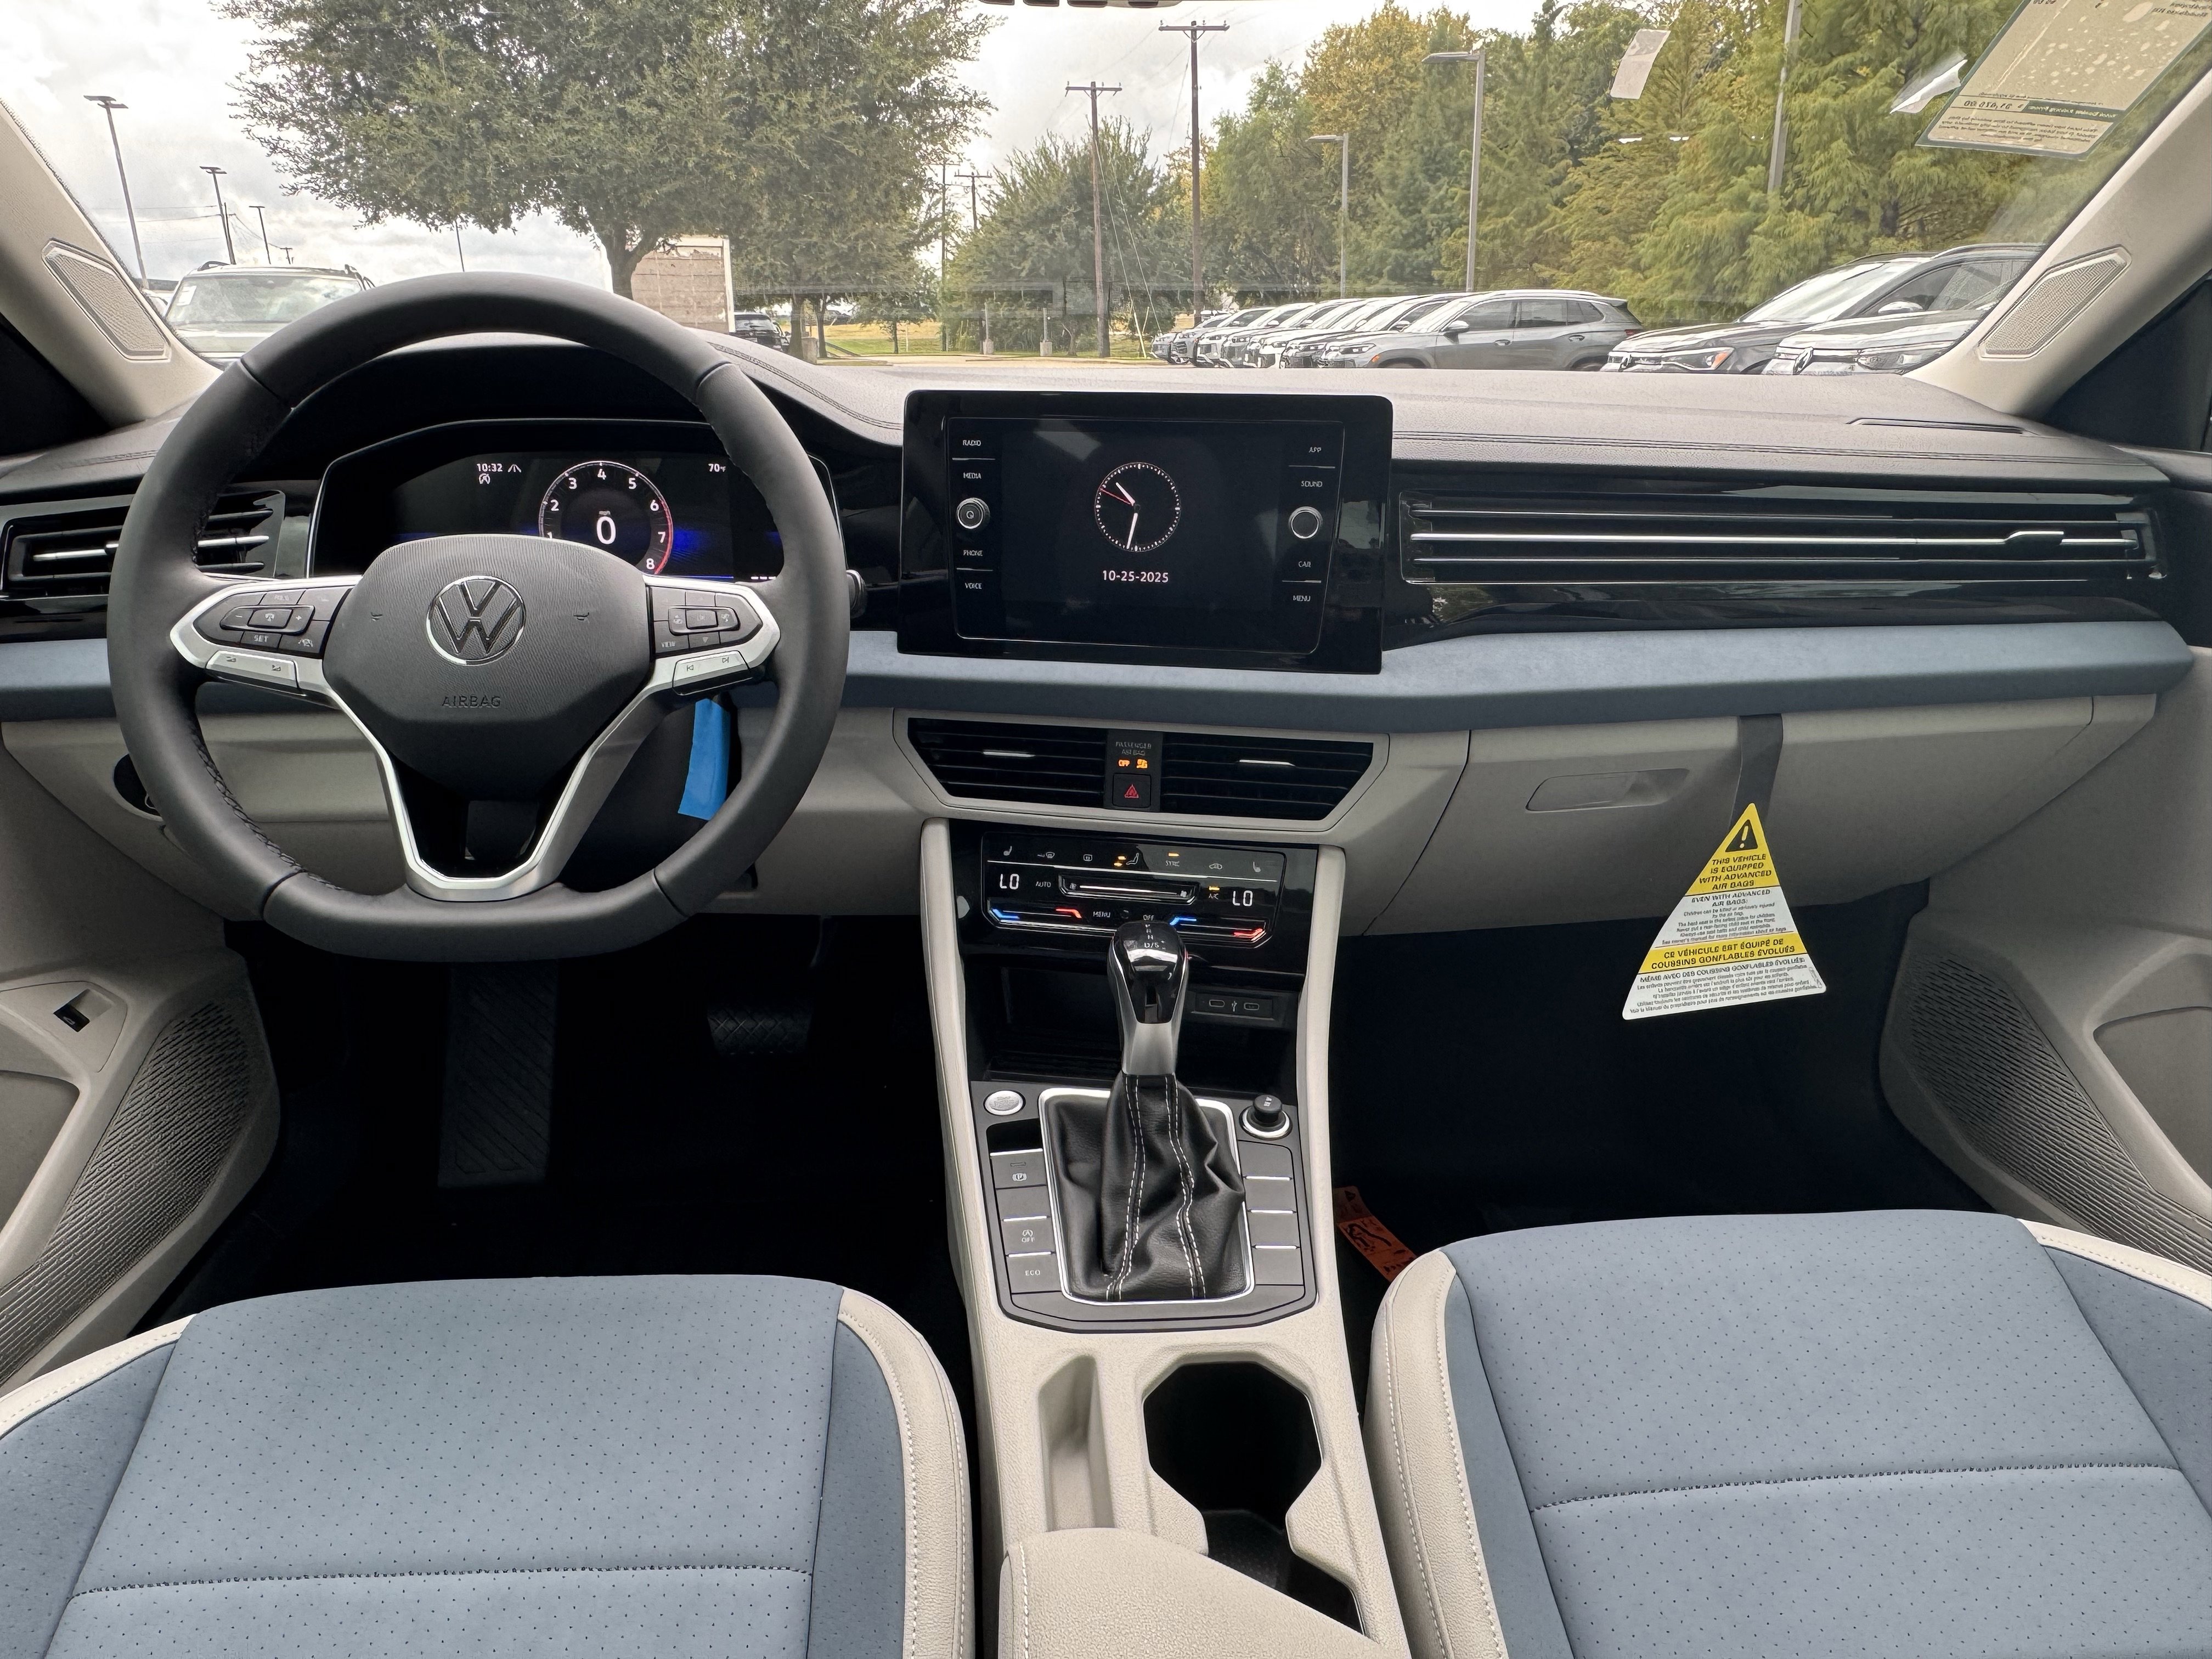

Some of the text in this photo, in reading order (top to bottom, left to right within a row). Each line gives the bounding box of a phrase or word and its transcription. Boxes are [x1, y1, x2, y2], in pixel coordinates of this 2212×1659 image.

[477, 463, 503, 472] 10:32
[597, 469, 607, 480] 4
[568, 477, 577, 489] 3
[628, 478, 637, 489] 5
[550, 500, 559, 511] 2
[650, 500, 659, 511] 6
[596, 516, 616, 545] 0
[658, 532, 666, 544] 7
[646, 558, 655, 569] 8
[1102, 570, 1169, 583] 10-25-2025
[442, 695, 501, 708] AIRBAG
[1733, 854, 1766, 863] VEHICLE
[1721, 862, 1764, 873] EQUIPPED
[999, 873, 1020, 890] LO
[1699, 870, 1771, 884] WITH ADVANCED
[1233, 890, 1254, 906] LO
[1732, 889, 1770, 898] ADVANCED
[1678, 946, 1719, 957] VÉHICULE
[1722, 944, 1738, 952] EST
[1740, 938, 1770, 950] ÉQUIPÉ
[1651, 945, 1795, 969] COUSSINS GONFLABLES ÉVOLUÉS
